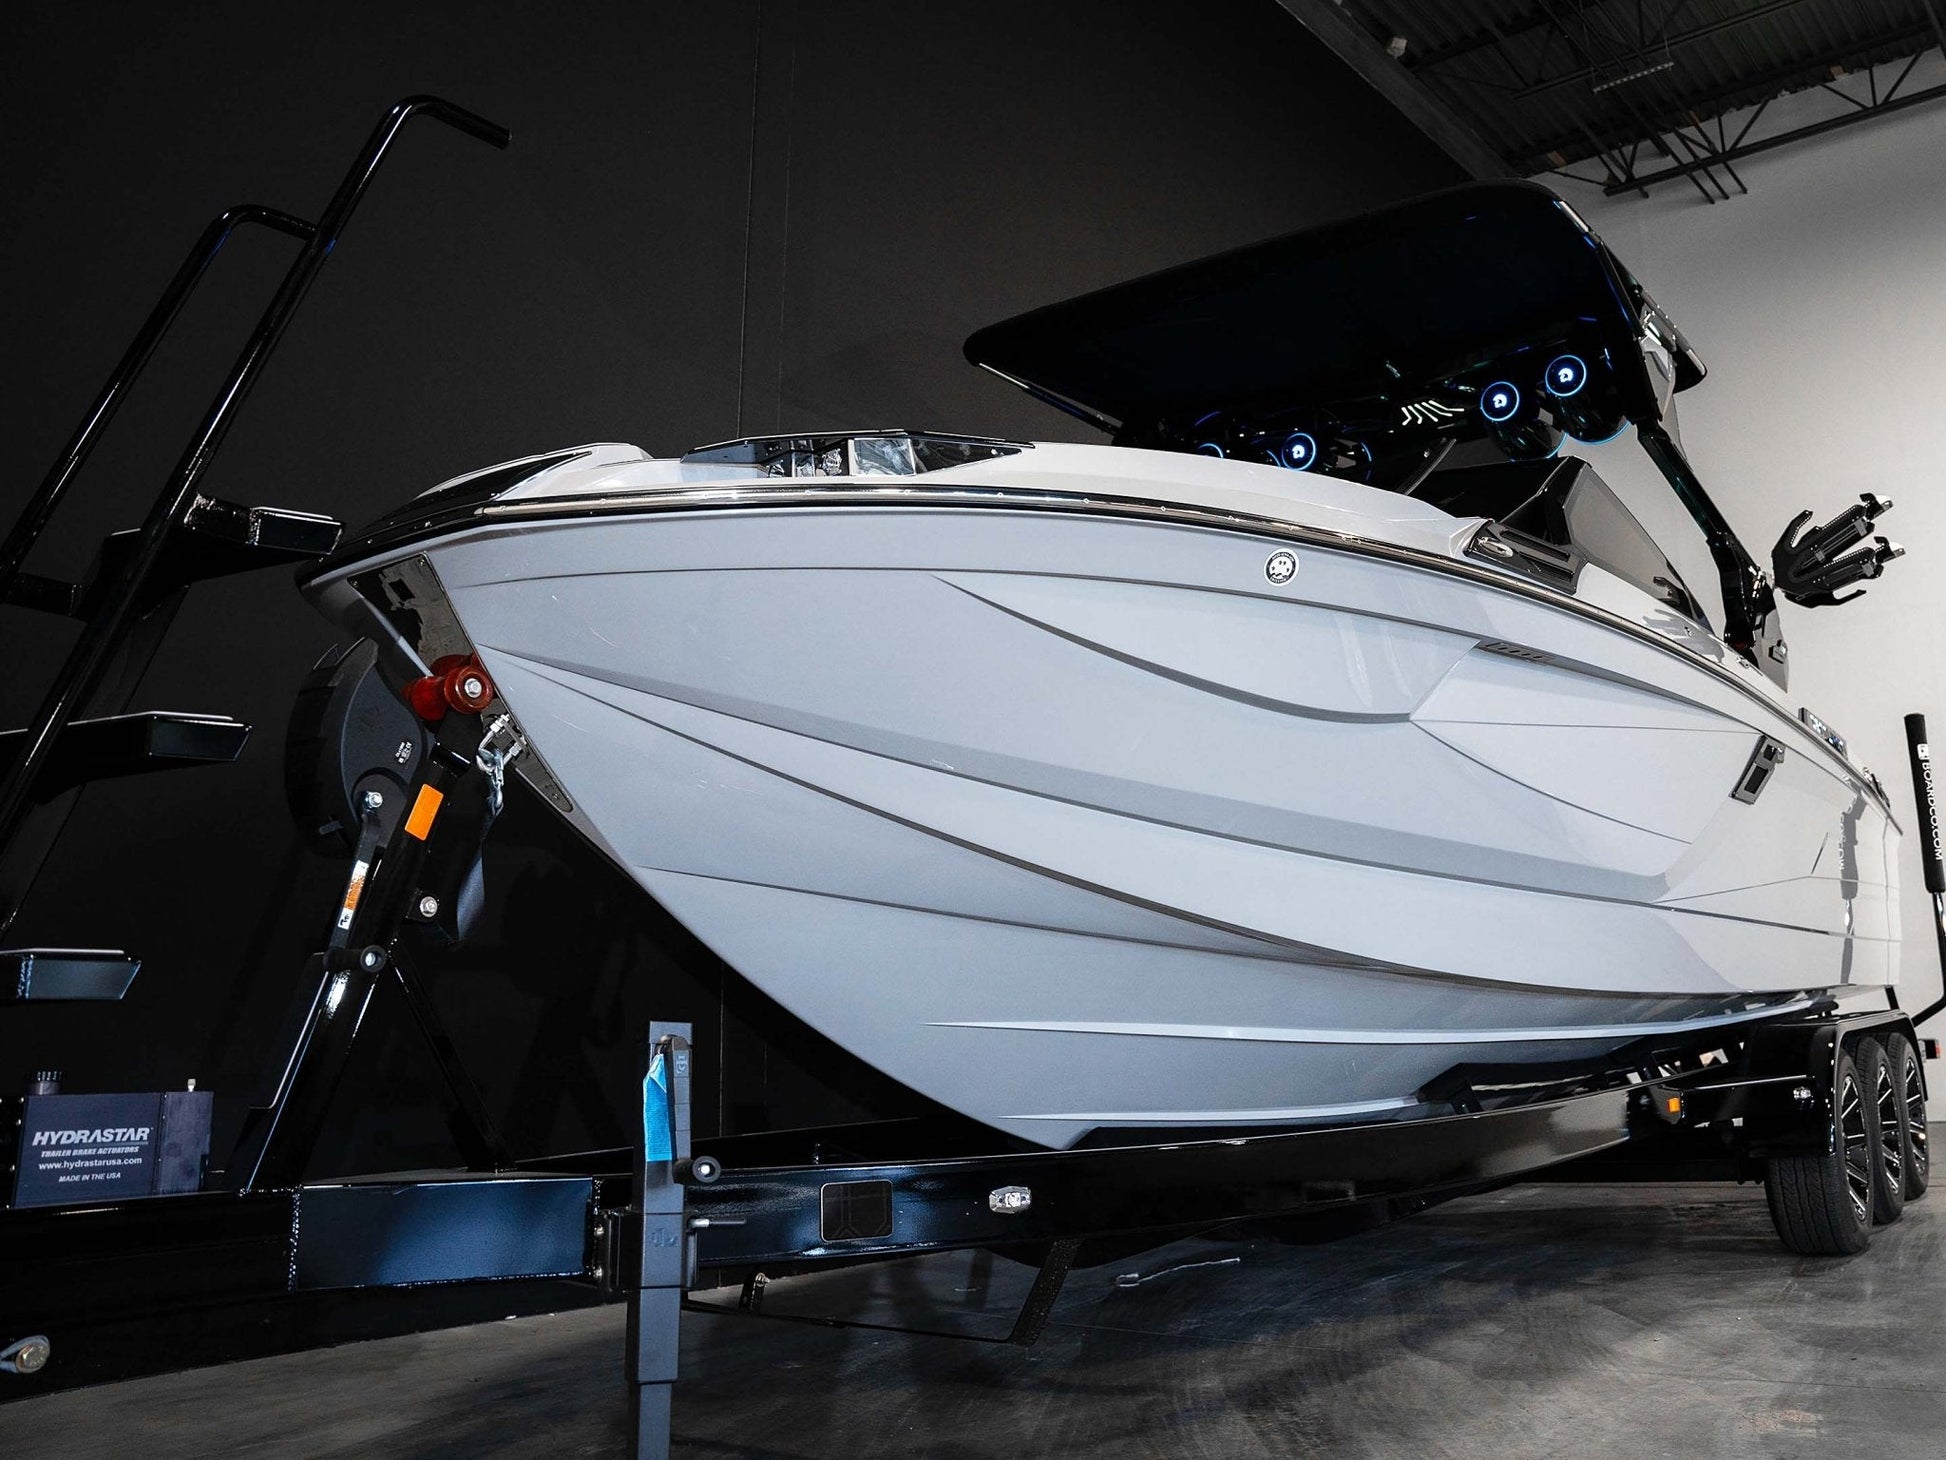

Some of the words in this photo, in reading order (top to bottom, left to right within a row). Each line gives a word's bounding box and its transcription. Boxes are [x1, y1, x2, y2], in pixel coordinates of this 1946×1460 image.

[1922, 762, 1943, 860] BOARDCO.COM
[32, 1127, 150, 1146] HYDRASTAR
[41, 1149, 72, 1158] TRAILER
[72, 1148, 97, 1157] BRAKE
[97, 1146, 140, 1155] ACTUATORS
[38, 1158, 143, 1170] www.hydrastarusa.com
[58, 1174, 81, 1182] MADE
